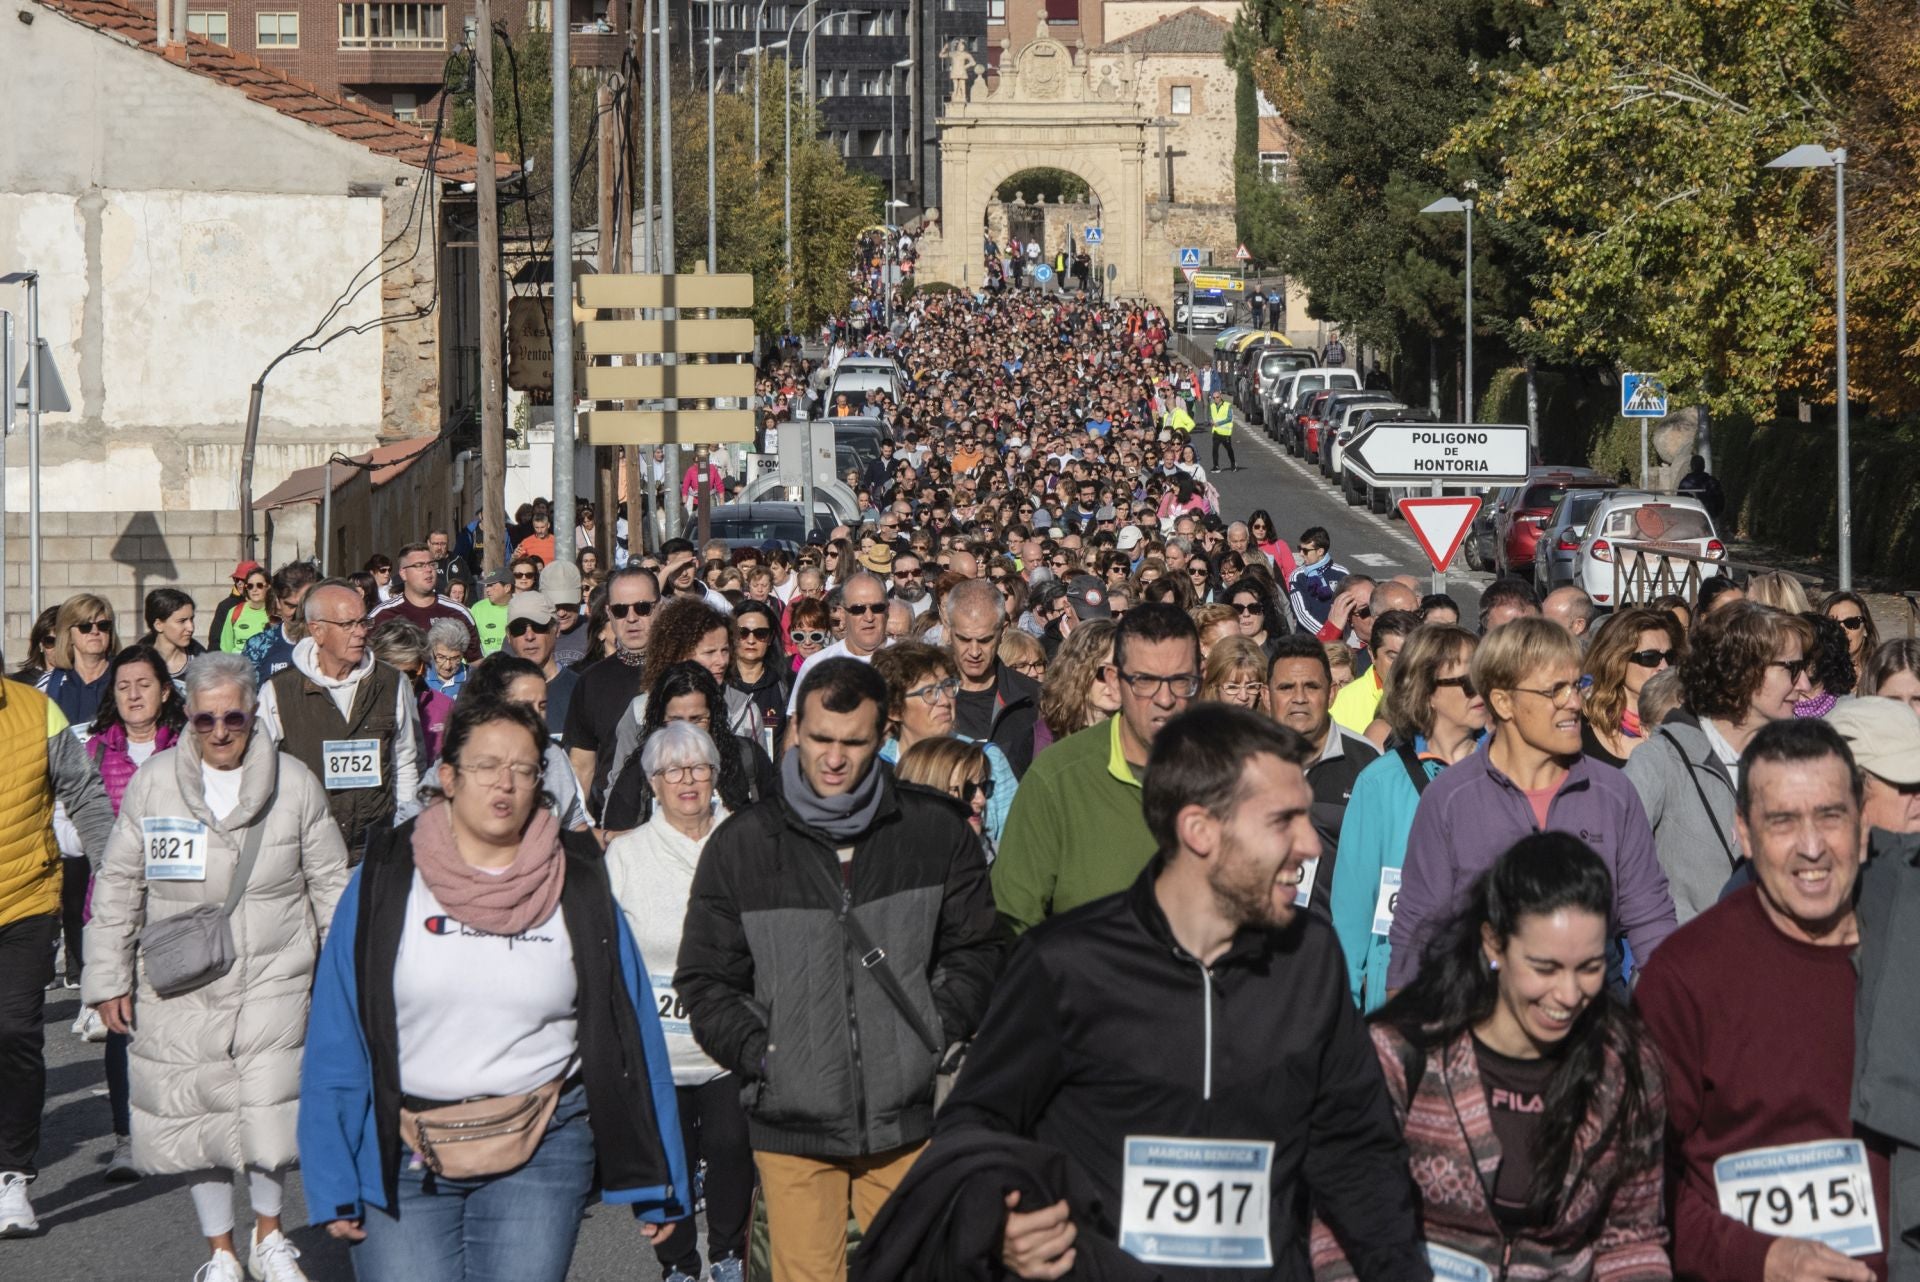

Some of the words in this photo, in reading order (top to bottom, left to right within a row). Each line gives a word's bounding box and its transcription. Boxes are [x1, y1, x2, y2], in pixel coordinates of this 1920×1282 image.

[1412, 432, 1488, 445] POLIGONO
[1444, 447, 1459, 456] DE
[757, 460, 779, 468] COM
[1414, 459, 1489, 472] HONTORIA
[330, 755, 373, 773] 8752
[151, 837, 194, 859] 6821
[1491, 1088, 1545, 1113] FILA
[1734, 1154, 1787, 1170] MARCHA
[1143, 1177, 1253, 1226] 7917
[1737, 1176, 1856, 1228] 7915
